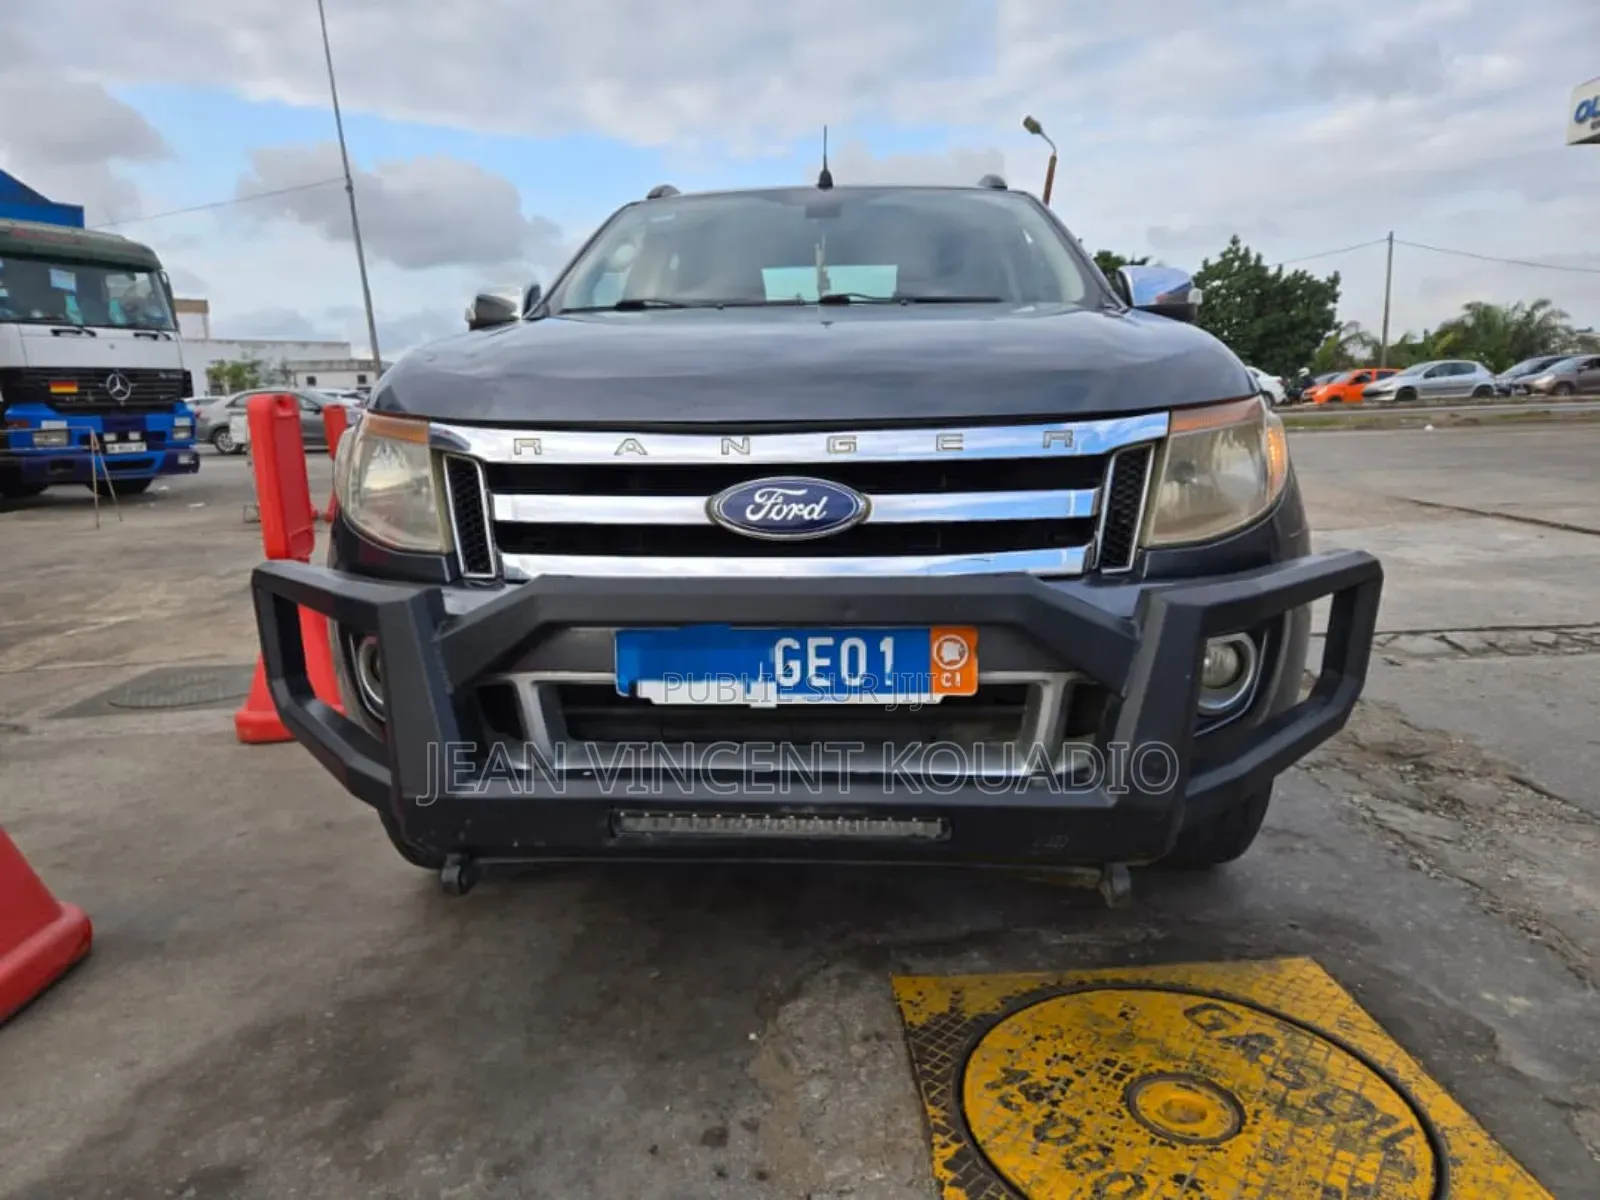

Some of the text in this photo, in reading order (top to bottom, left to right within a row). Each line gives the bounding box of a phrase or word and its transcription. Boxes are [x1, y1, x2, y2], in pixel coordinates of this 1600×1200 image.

[513, 430, 1074, 456] RANGER
[745, 487, 828, 521] Ford
[941, 672, 961, 688] CI
